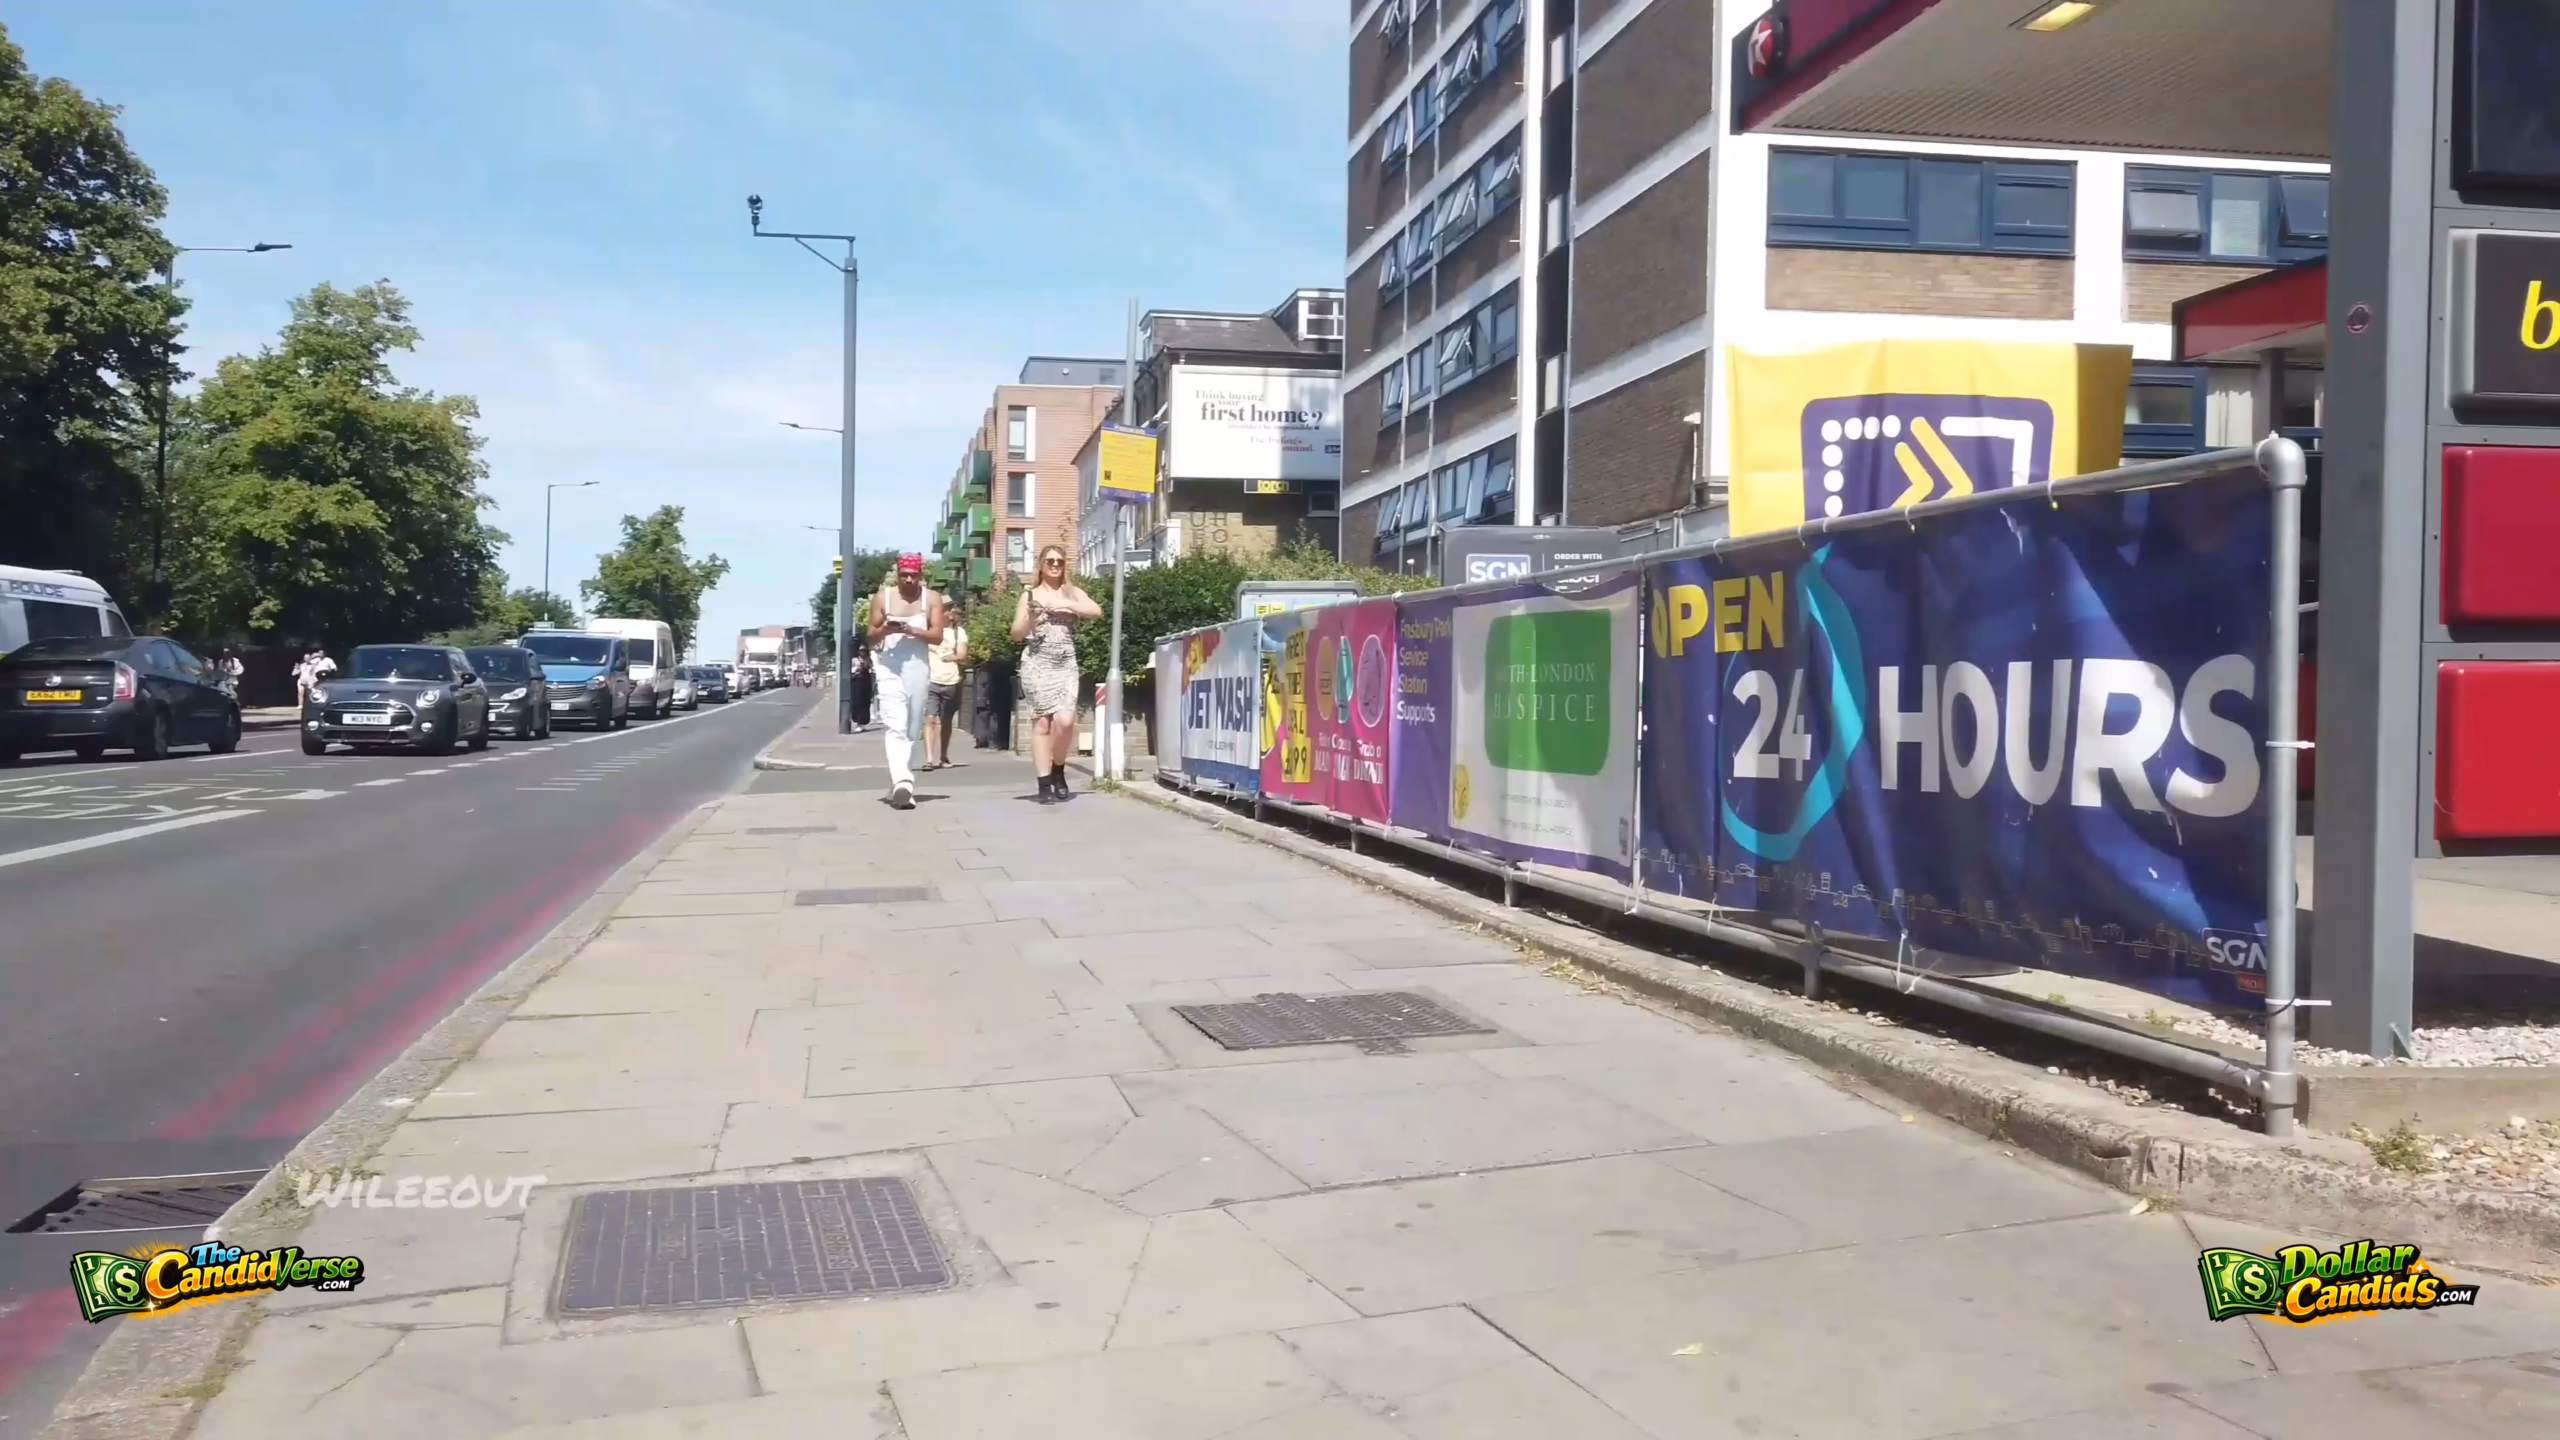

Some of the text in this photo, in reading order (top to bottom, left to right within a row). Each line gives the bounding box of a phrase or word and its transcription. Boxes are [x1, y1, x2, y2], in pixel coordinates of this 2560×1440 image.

[1201, 402, 1246, 421] first
[1470, 561, 1527, 582] SGN
[10, 581, 64, 597] POLICE
[1651, 571, 1784, 658] OPEN
[1400, 618, 1434, 643] Fnsbury
[1188, 679, 1211, 729] JET
[1214, 676, 1253, 733] WASH
[1732, 654, 2261, 817] 24 HOURS
[0, 803, 219, 820] KEE
[2206, 936, 2267, 970] SGN
